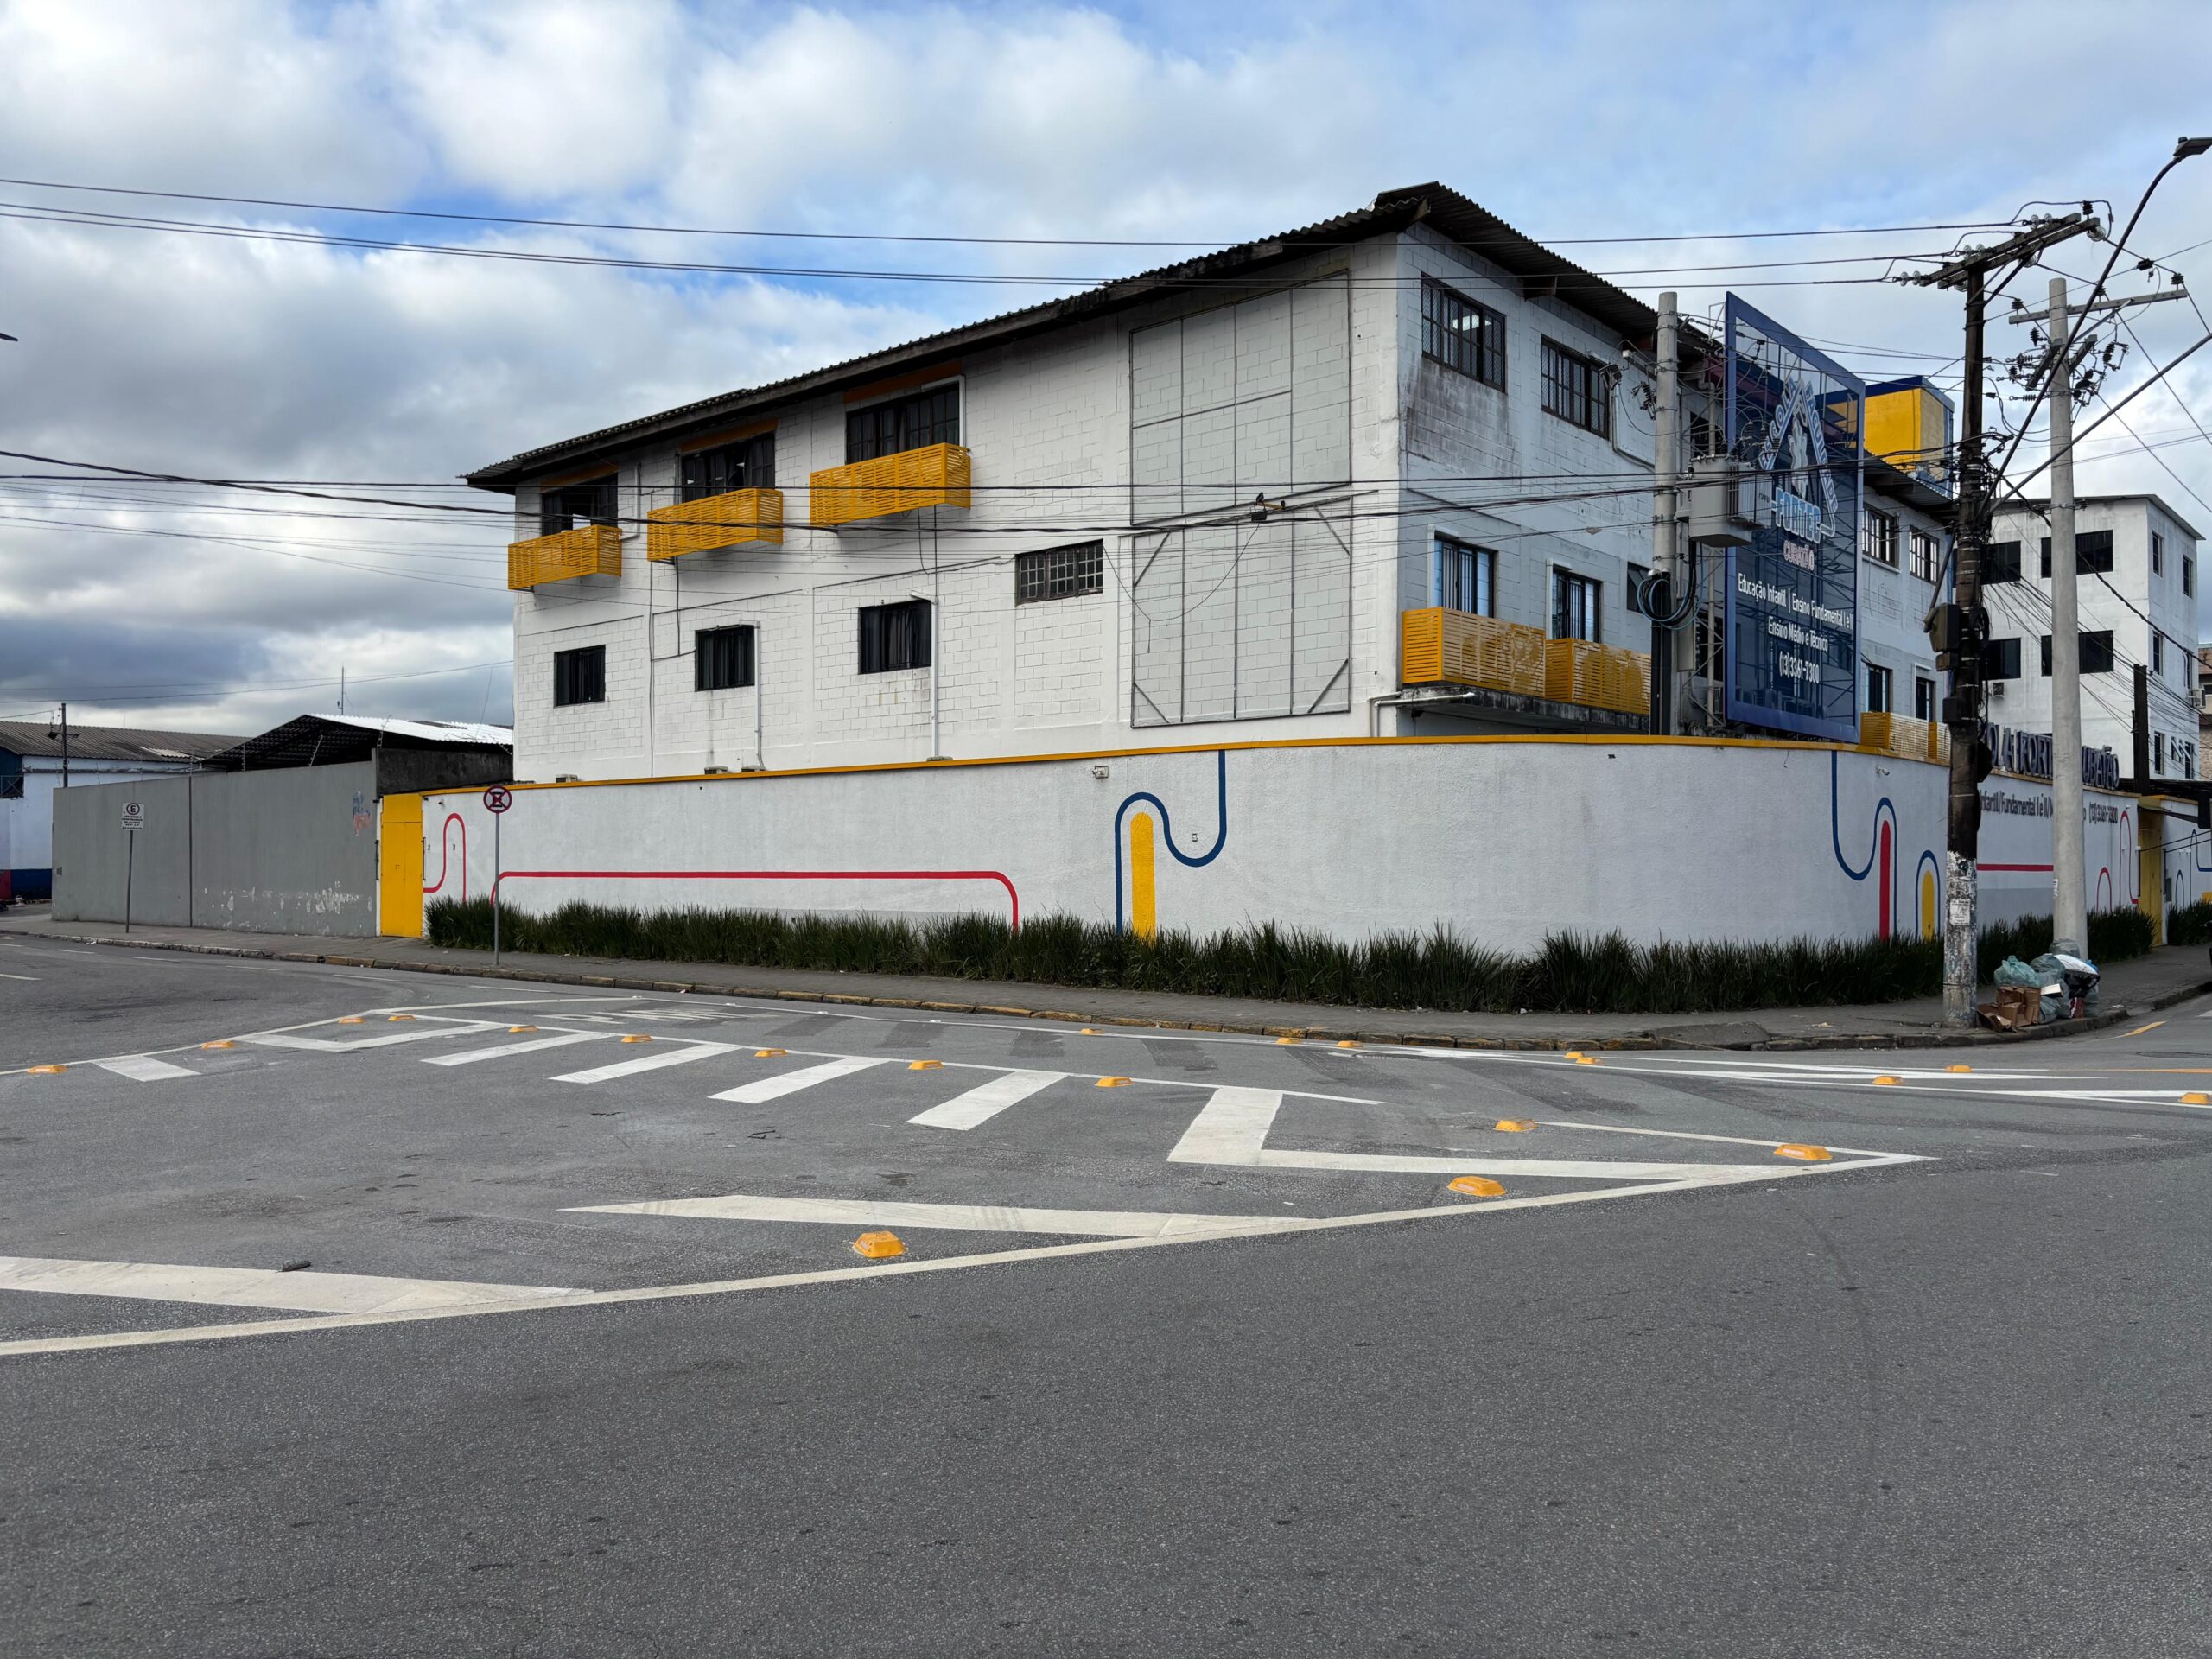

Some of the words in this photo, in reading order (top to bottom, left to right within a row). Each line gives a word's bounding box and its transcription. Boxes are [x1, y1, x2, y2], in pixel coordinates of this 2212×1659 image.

[1783, 539, 1815, 571] CUBATÃO
[1738, 572, 1767, 602] Educação
[1767, 583, 1787, 607] Infantil
[1792, 593, 1811, 616] Ensino
[1811, 600, 1843, 627] Fundamental
[1768, 615, 1789, 640] Ensino
[1789, 622, 1805, 645] Médio
[1809, 629, 1829, 652] Técnico
[1779, 650, 1820, 684] (13)3361-7300
